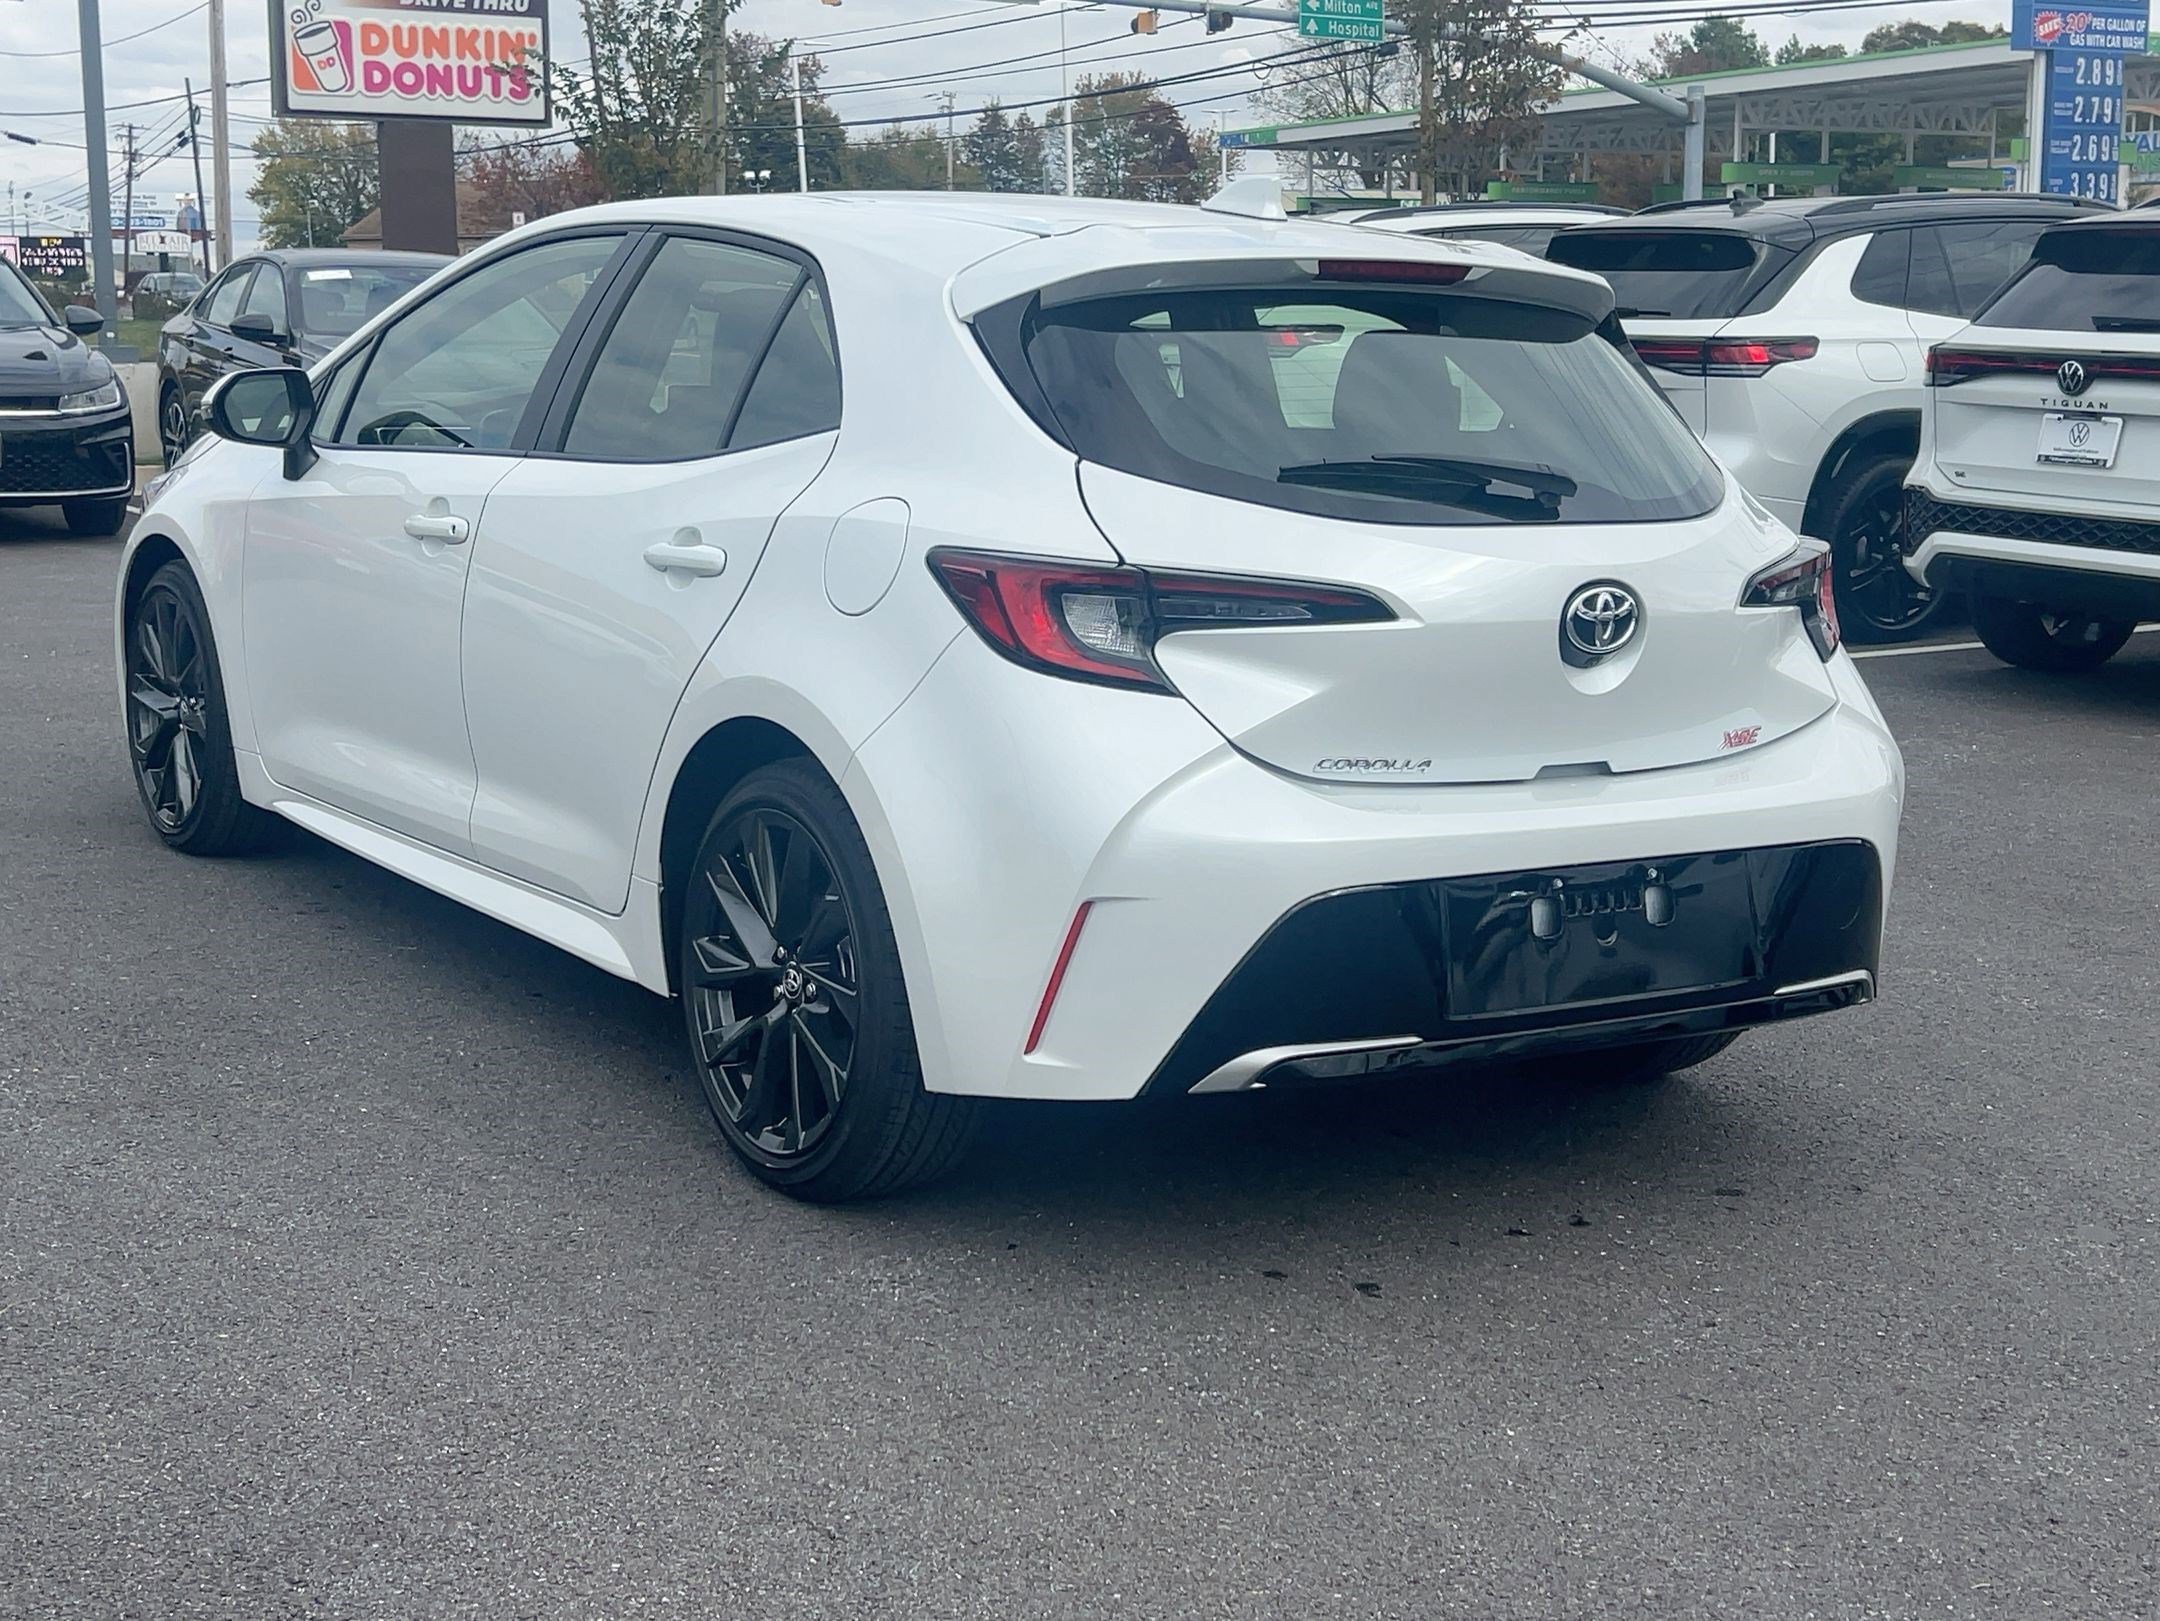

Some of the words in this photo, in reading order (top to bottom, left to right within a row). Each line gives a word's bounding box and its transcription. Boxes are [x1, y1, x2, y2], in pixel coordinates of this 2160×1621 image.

[1324, 0, 1361, 14] Milton
[1328, 21, 1379, 37] Hospital
[2092, 17, 2105, 30] PER
[2106, 18, 2135, 32] GALLON
[2136, 20, 2146, 32] OF
[360, 22, 537, 64] DUNKIN'
[2070, 33, 2085, 46] GAS
[2086, 34, 2105, 47] WITH
[2106, 35, 2121, 48] CAR
[317, 56, 336, 70] DD
[2076, 57, 2114, 86] 2.89
[363, 61, 531, 100] DONUTS
[2074, 96, 2112, 124] 2.79
[2072, 134, 2110, 162] 2.69
[2040, 398, 2109, 410] TIGUAN
[1719, 725, 1762, 750] XSE
[1313, 757, 1433, 775] COROLLA
